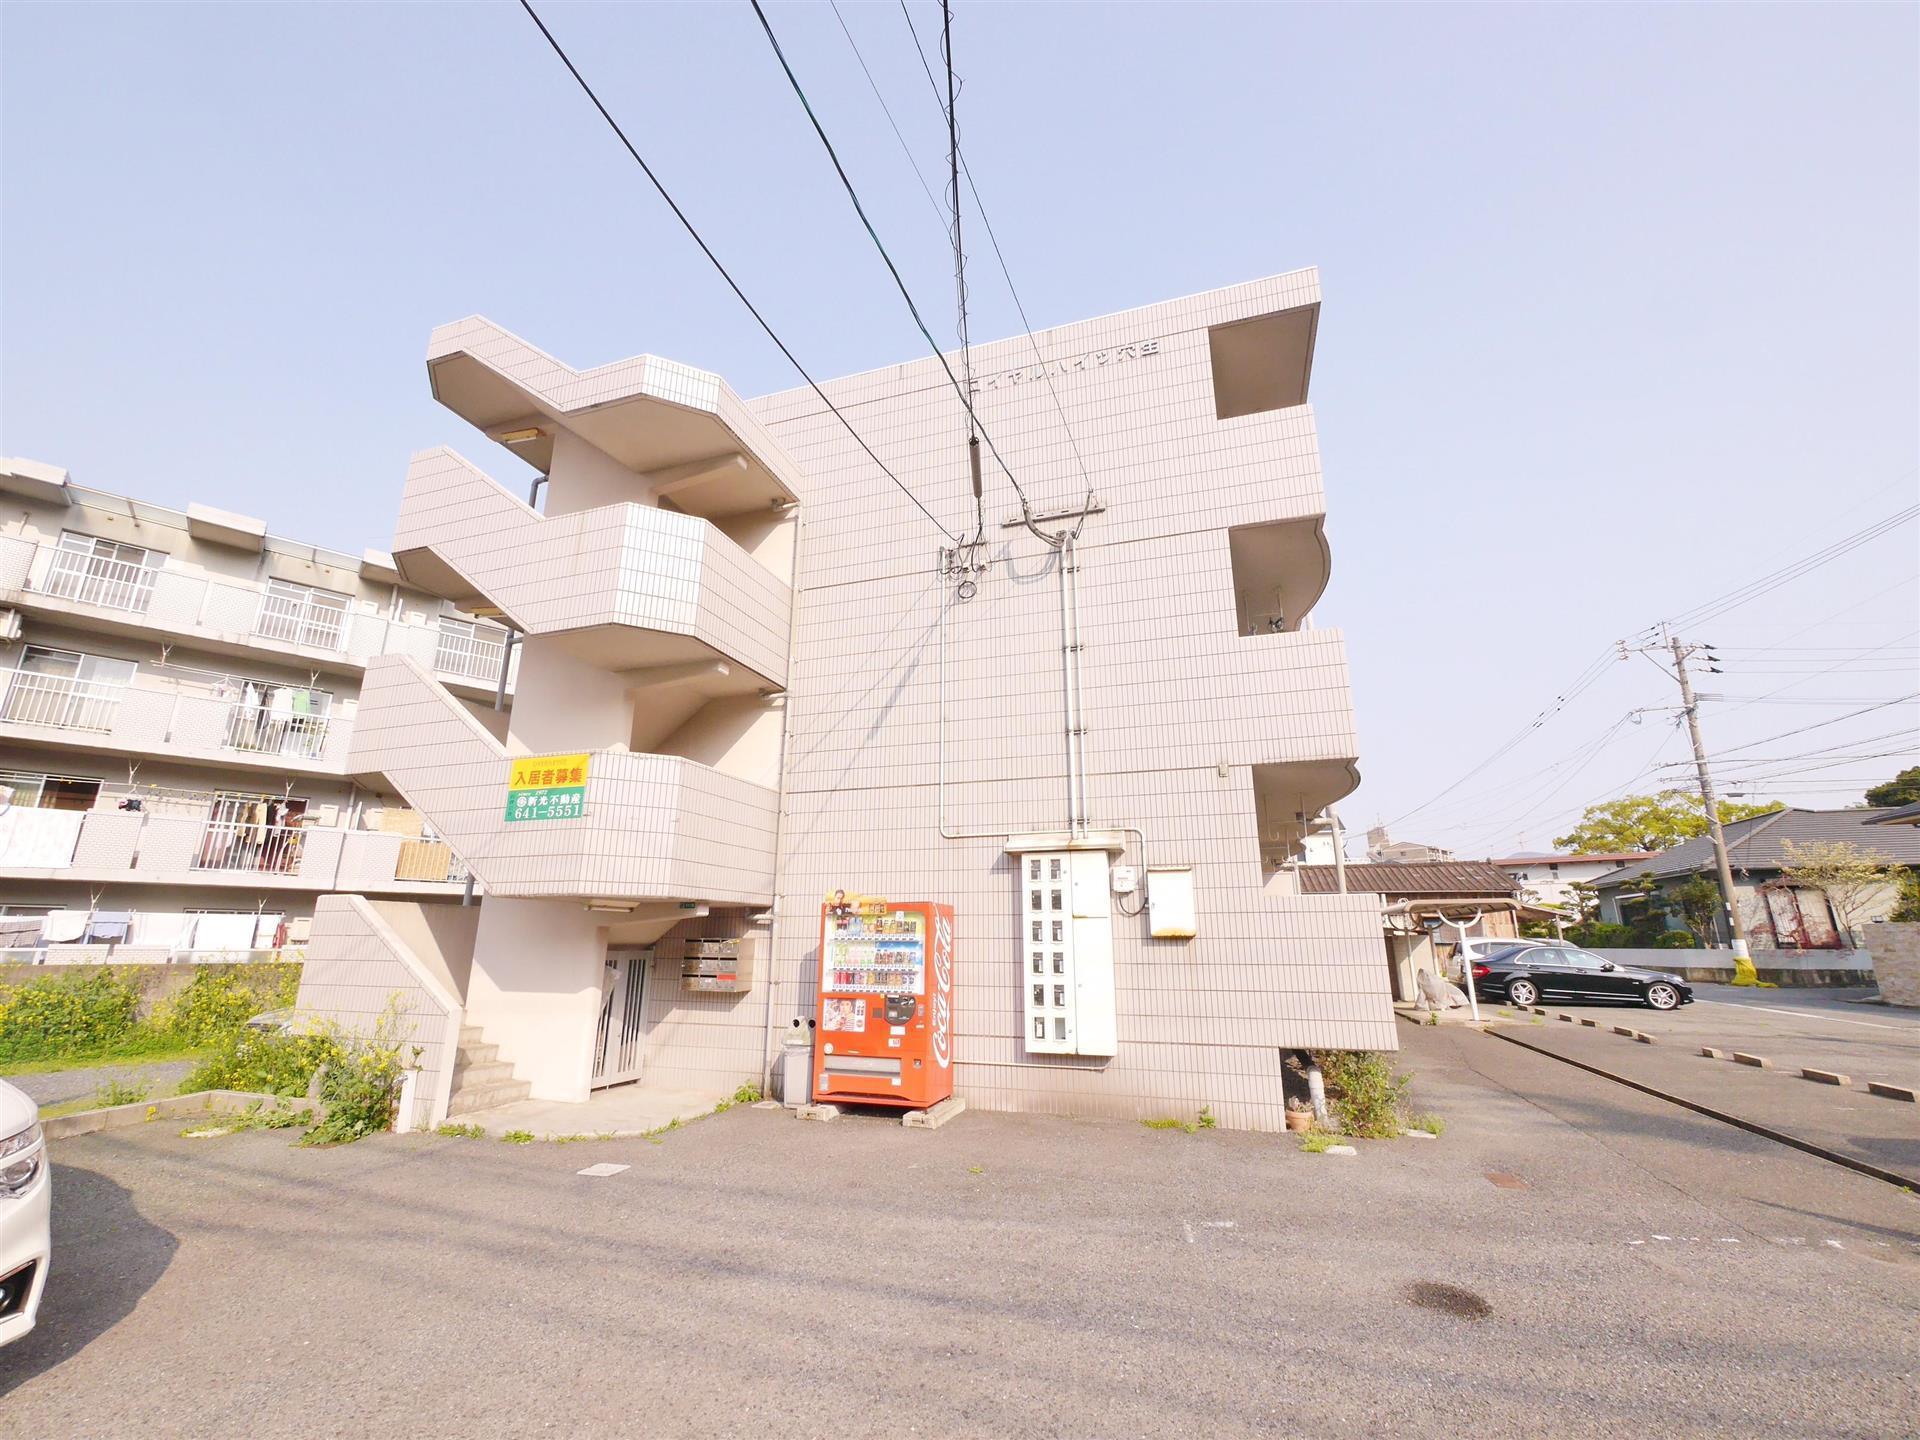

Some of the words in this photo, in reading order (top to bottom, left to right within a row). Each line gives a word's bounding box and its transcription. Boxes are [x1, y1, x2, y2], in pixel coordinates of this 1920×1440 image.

[514, 768, 583, 785] 入居者募集
[515, 805, 580, 819] 641-5551
